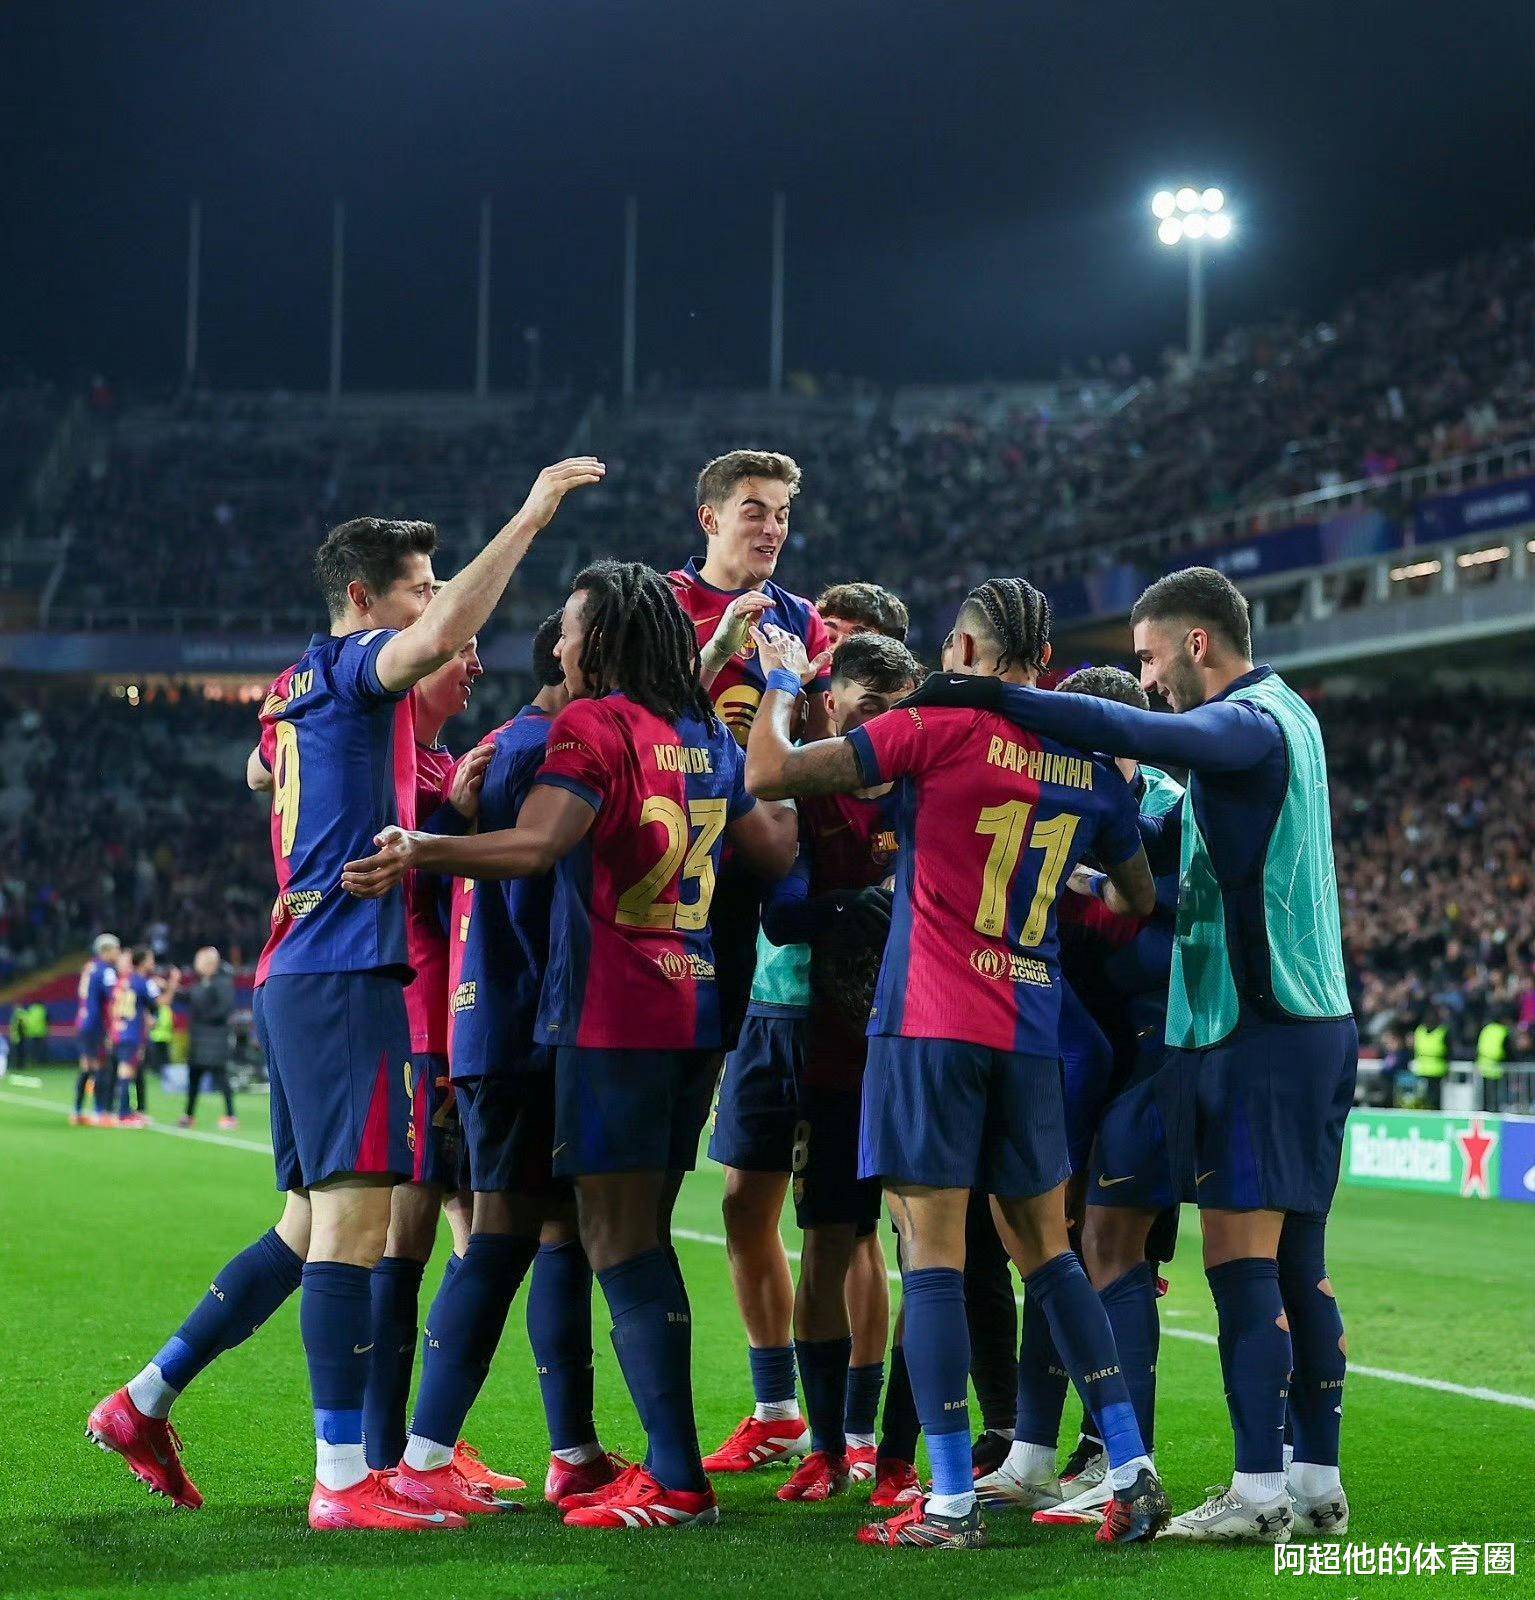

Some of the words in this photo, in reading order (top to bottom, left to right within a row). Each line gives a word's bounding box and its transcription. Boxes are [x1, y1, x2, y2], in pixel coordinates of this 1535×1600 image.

[274, 720, 301, 858] 9
[986, 734, 1093, 791] RAPHINHA
[615, 795, 728, 932] 23
[974, 799, 1082, 947] 11
[282, 890, 323, 906] UNHCR
[1008, 952, 1048, 973] UNHCR
[1008, 964, 1052, 983] ACNUR
[792, 1119, 812, 1173] 8
